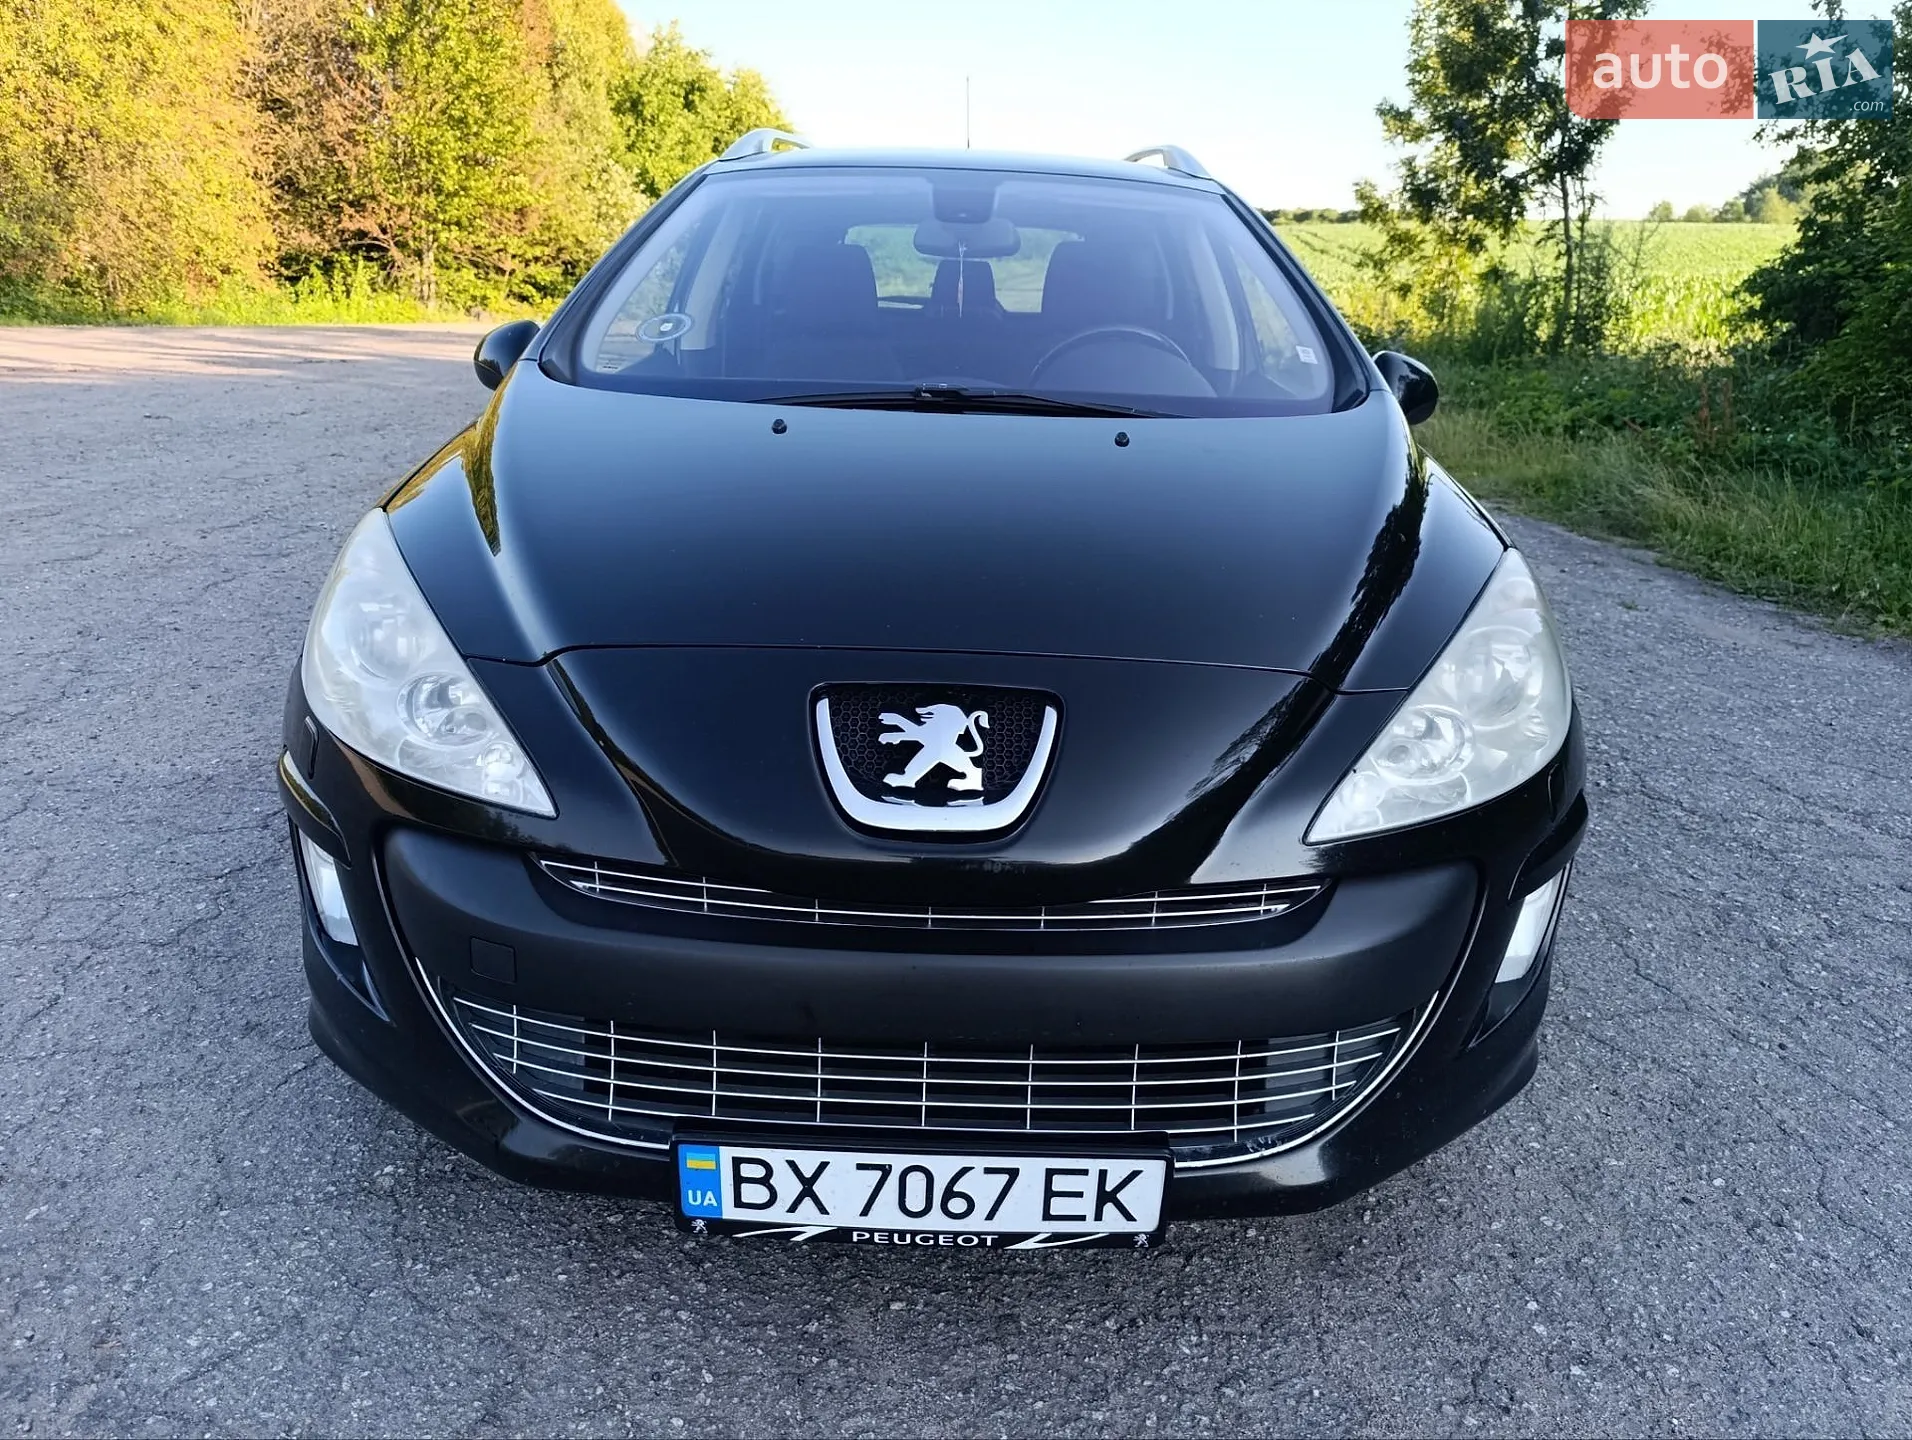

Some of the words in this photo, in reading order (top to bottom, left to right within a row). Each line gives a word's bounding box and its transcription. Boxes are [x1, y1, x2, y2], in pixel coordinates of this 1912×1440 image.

[687, 1189, 718, 1208] UA
[731, 1156, 830, 1216] BX
[855, 1162, 1020, 1222] 7067
[1041, 1168, 1145, 1223] EK
[852, 1231, 999, 1248] PEUGEOT
